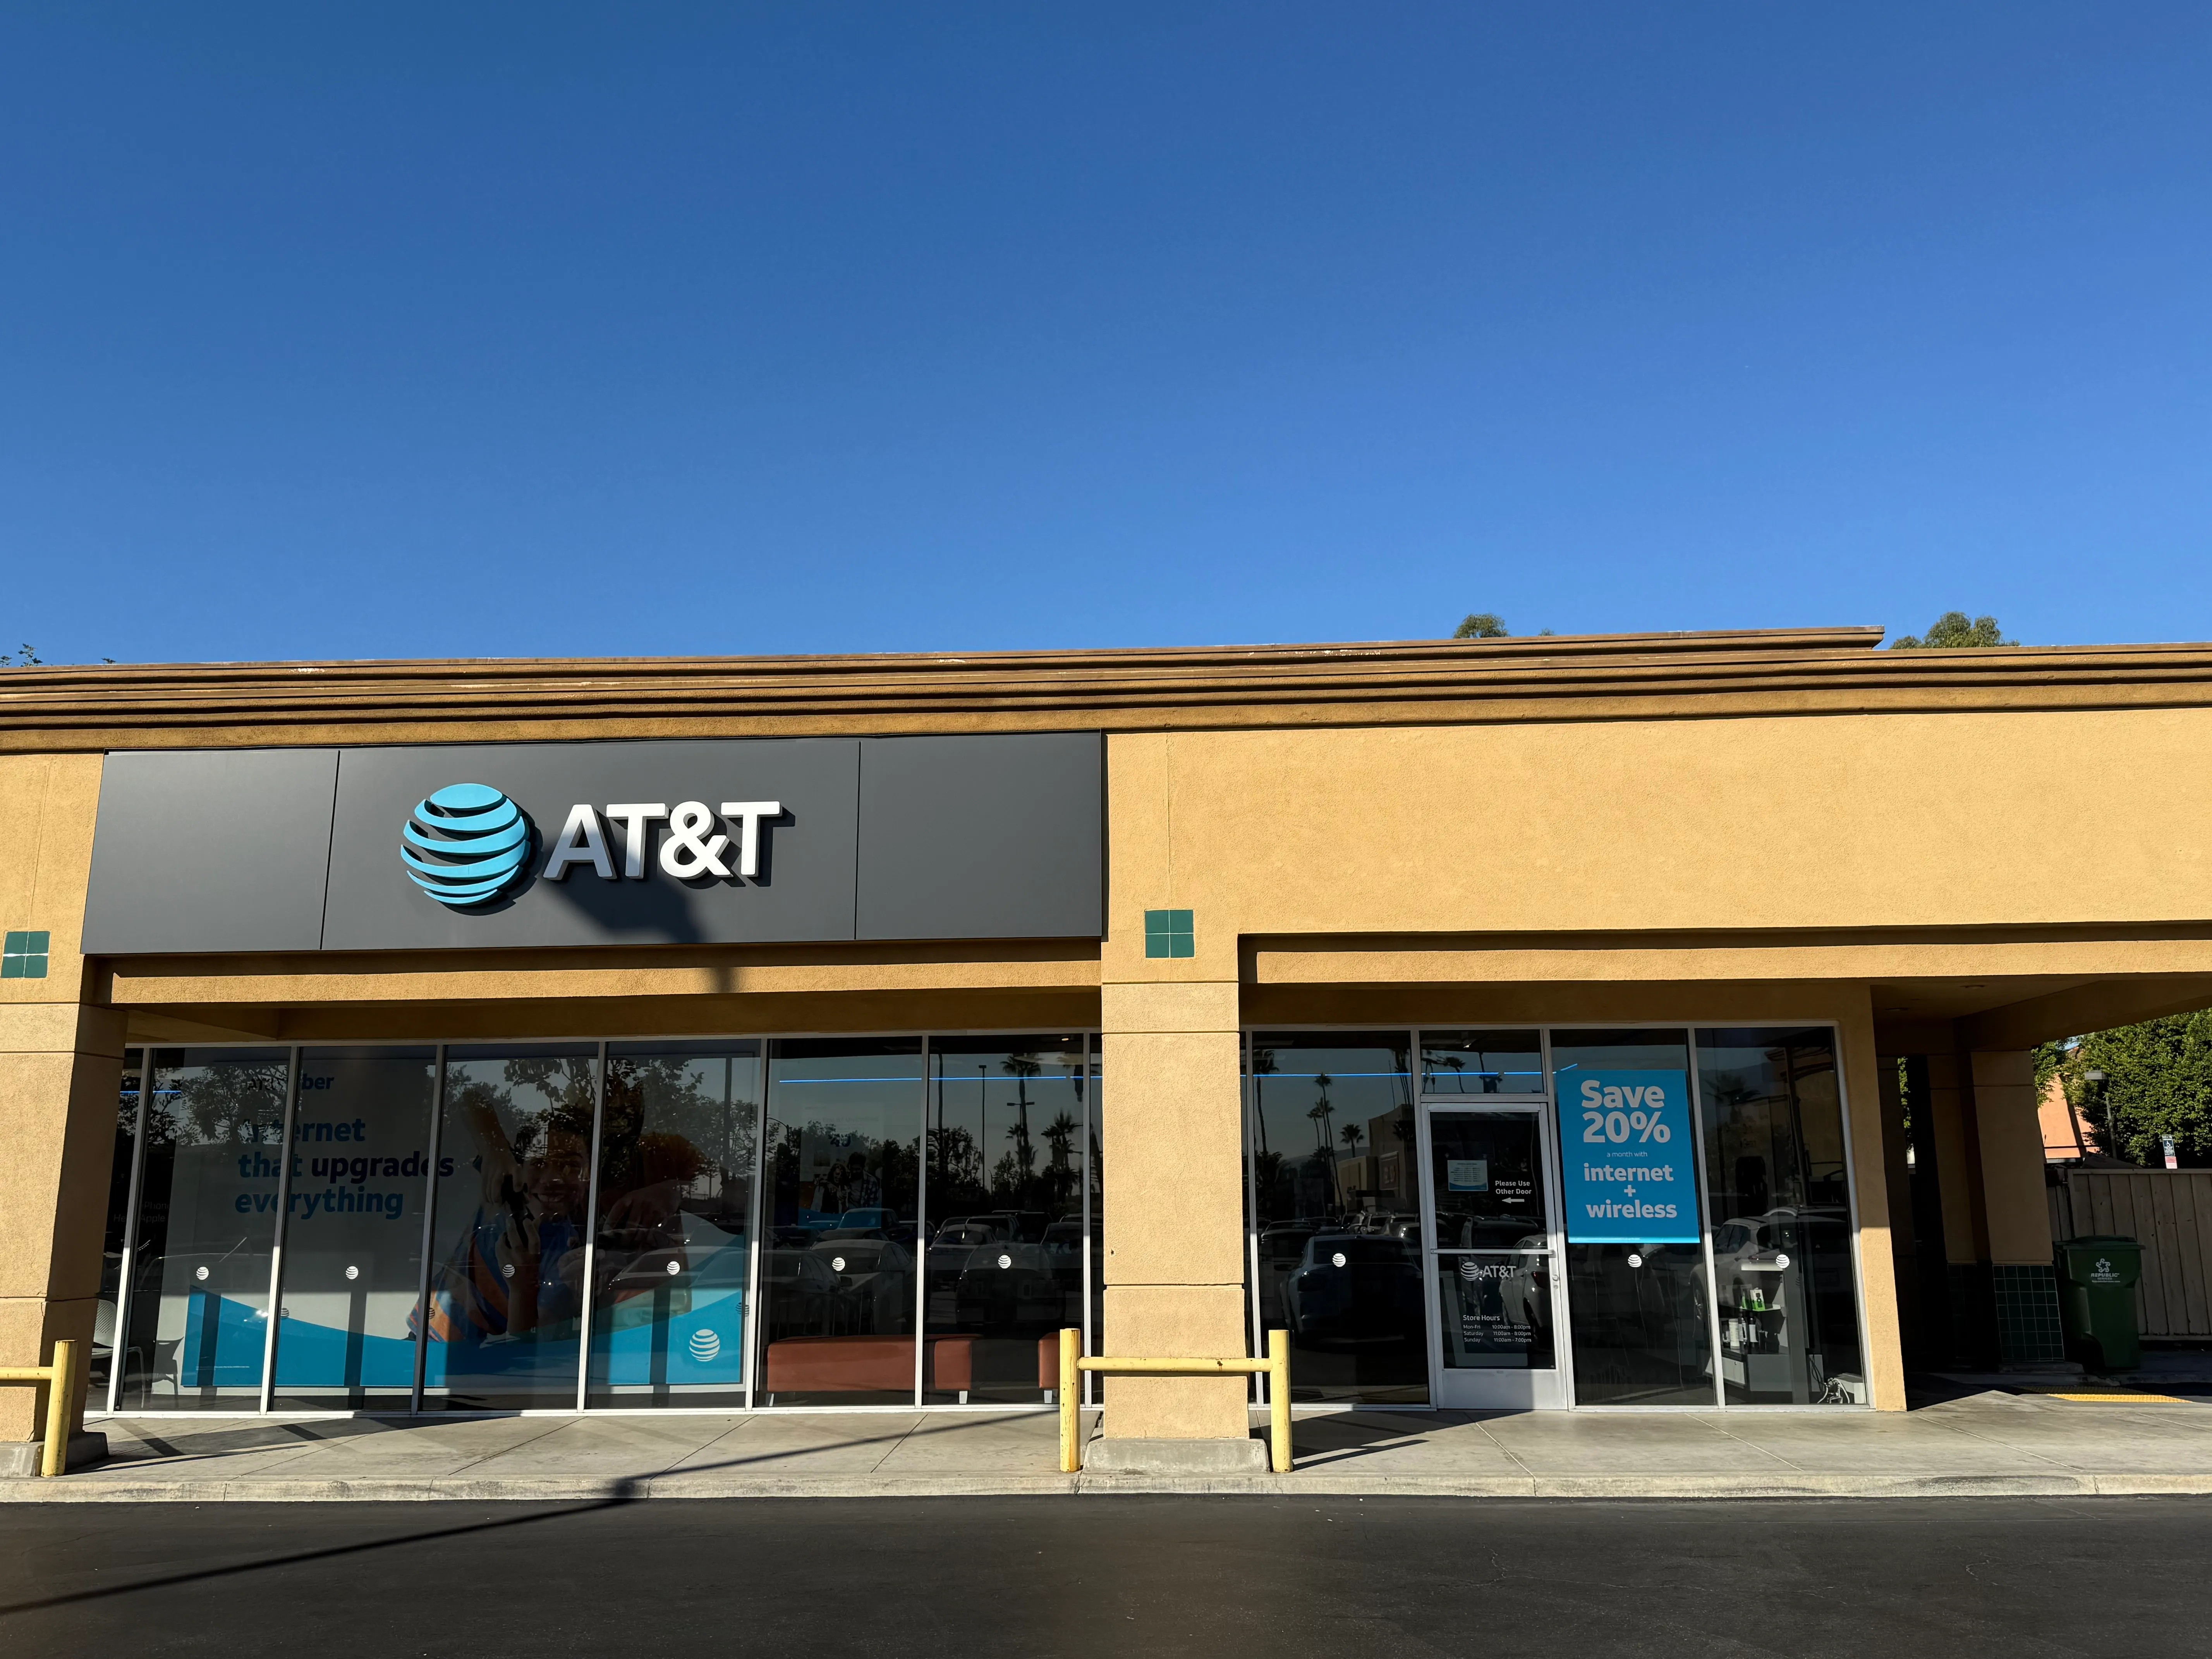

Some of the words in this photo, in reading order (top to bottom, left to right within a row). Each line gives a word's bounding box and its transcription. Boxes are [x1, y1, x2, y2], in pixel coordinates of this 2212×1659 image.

[543, 800, 781, 880] AT&T
[1581, 1080, 1664, 1108] Save
[1582, 1111, 1671, 1143] 20%
[238, 1152, 302, 1178] that
[1584, 1163, 1674, 1181] internet
[1624, 1185, 1636, 1197] +
[1585, 1199, 1677, 1218] wireless
[1482, 1265, 1516, 1278] AT&T
